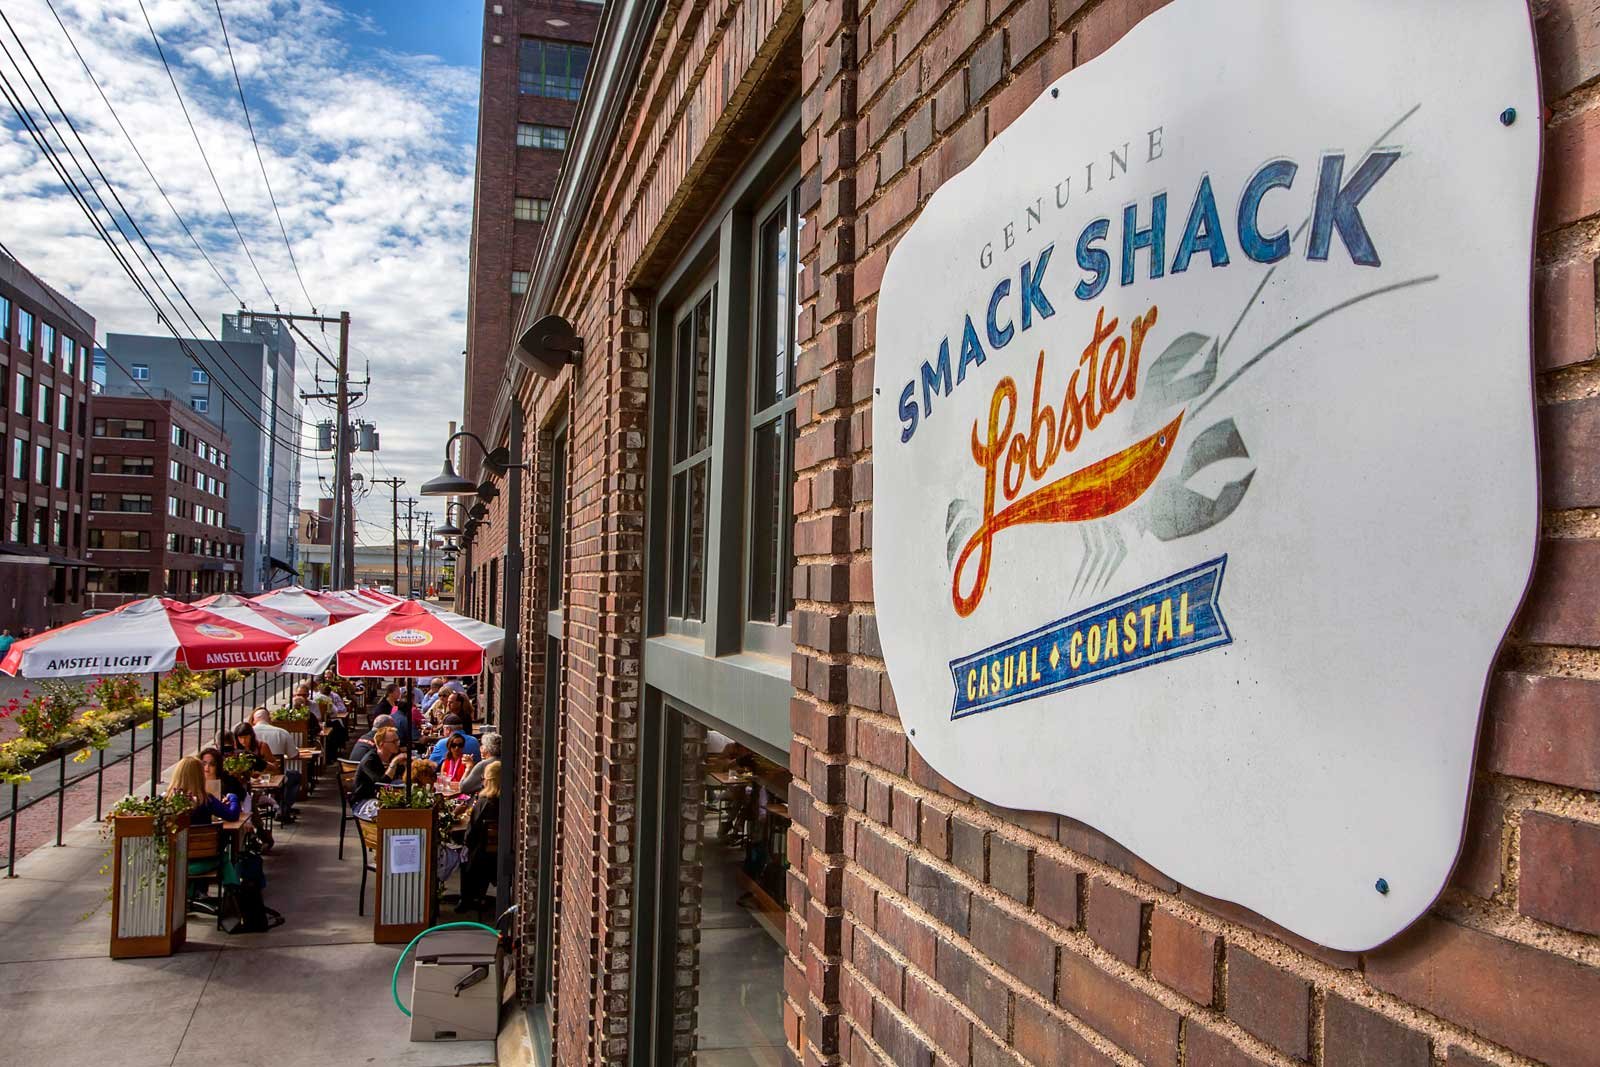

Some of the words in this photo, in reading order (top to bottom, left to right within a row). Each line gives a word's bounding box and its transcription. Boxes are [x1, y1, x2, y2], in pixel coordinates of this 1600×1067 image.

[979, 125, 1165, 271] GENUINE
[897, 243, 1056, 443] SMACK
[1074, 147, 1403, 300] SHACK
[952, 305, 1158, 618] Lobster
[46, 656, 99, 670] AMSTEL
[104, 655, 153, 667] LIGHT
[206, 651, 247, 664] AMSTEL
[248, 651, 281, 662] LIGHT
[360, 659, 411, 671] AMSTEL
[415, 659, 460, 671] LIGHT
[966, 646, 1041, 701] CASUAL
[1069, 591, 1197, 669] COASTAL
